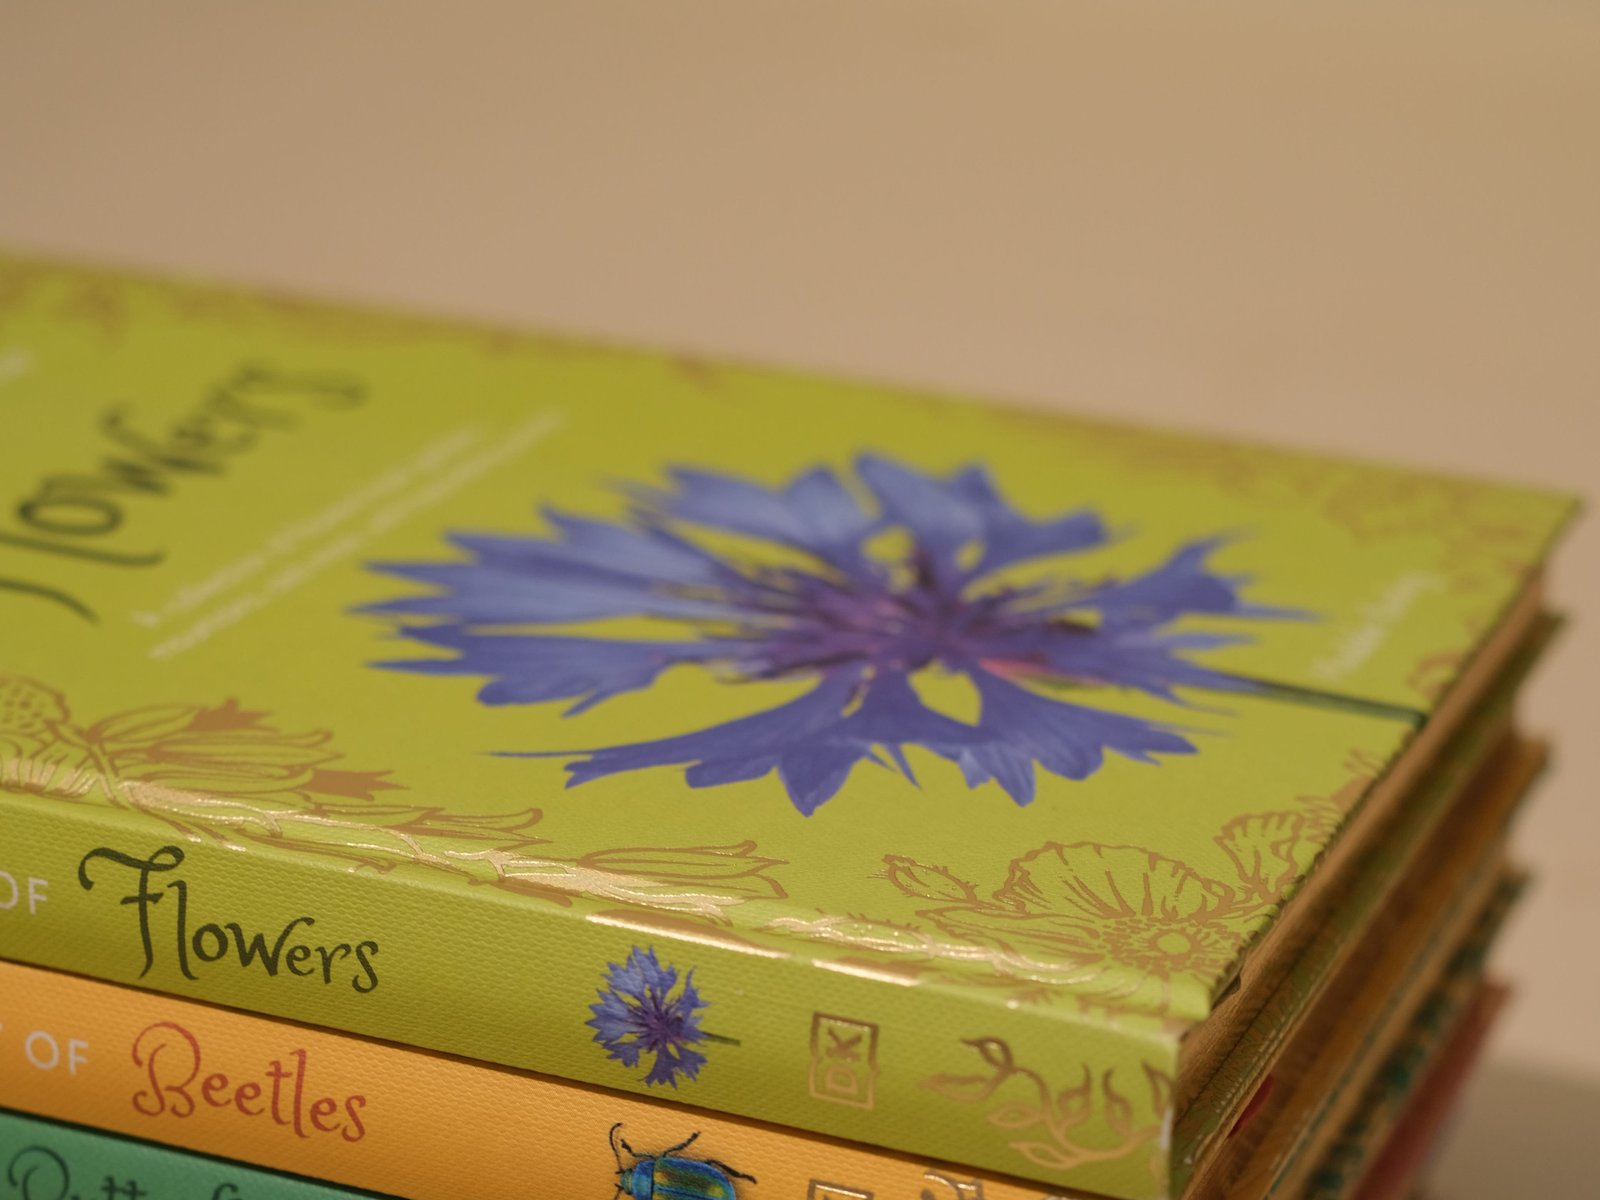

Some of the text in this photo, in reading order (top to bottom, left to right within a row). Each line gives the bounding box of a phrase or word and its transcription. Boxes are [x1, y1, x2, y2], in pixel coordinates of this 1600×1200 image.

[0, 360, 368, 625] lowers
[78, 845, 379, 993] Flowers
[25, 1022, 367, 1142] OF Beetles
